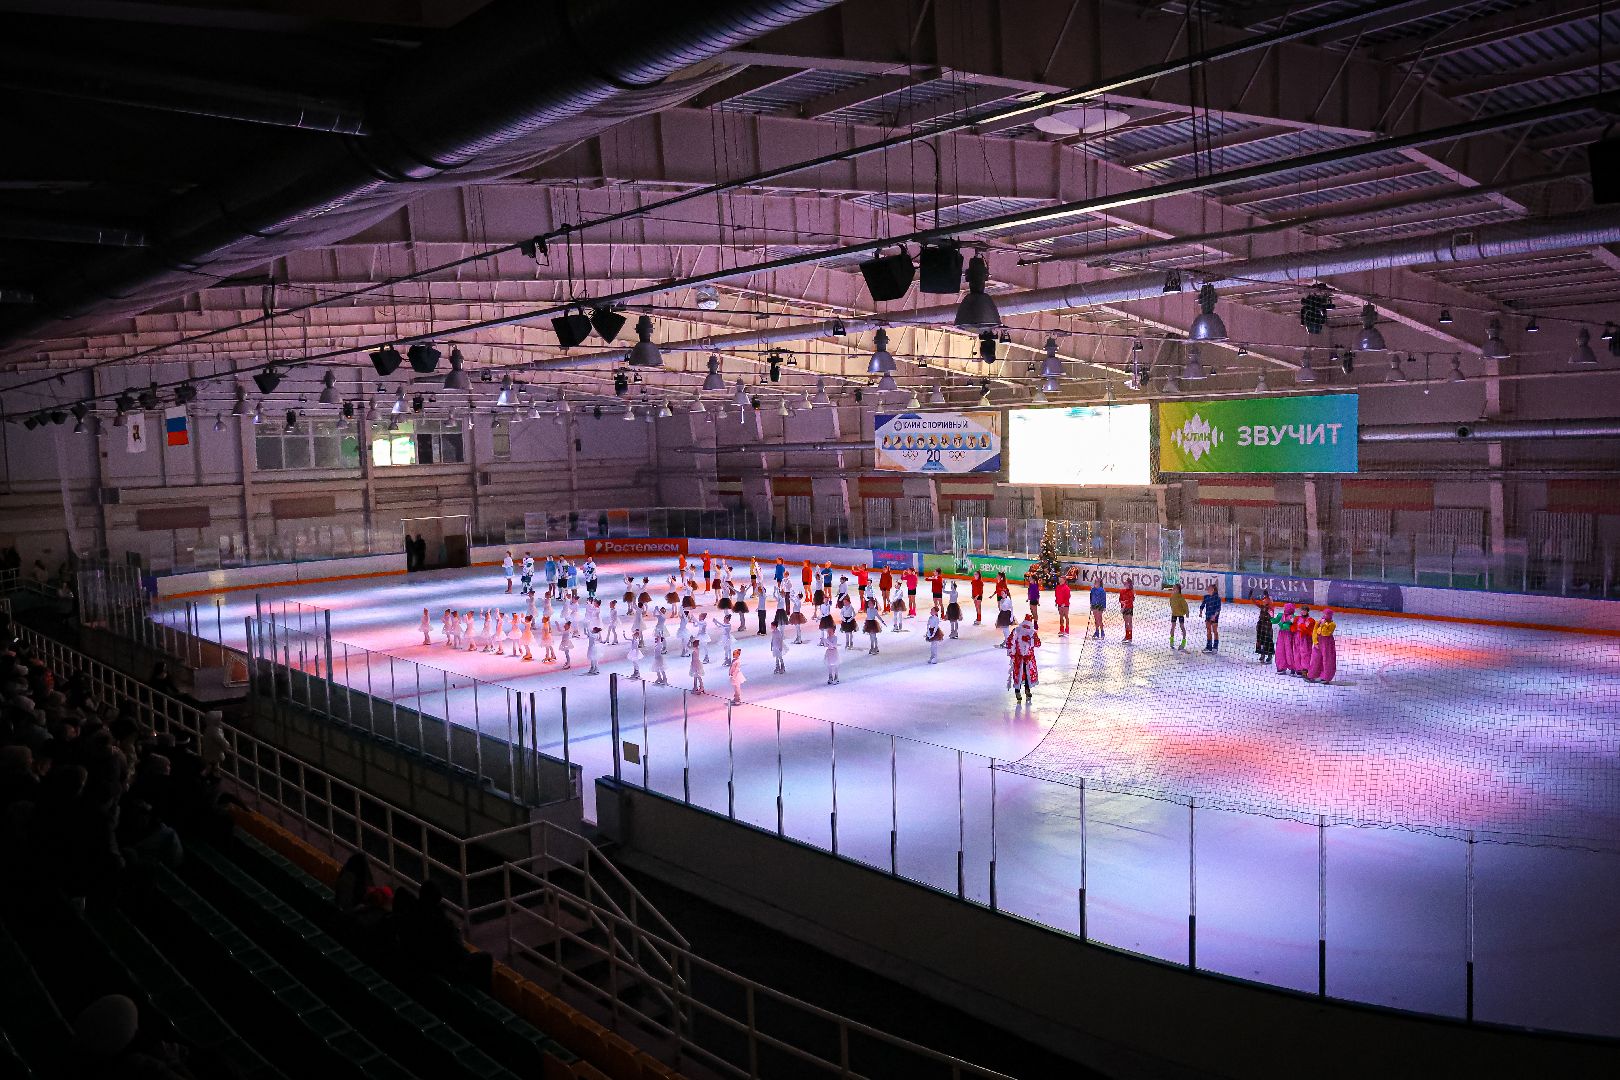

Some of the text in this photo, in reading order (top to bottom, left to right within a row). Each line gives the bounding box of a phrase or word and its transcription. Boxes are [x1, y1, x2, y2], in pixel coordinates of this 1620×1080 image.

[903, 419, 968, 429] КЛИН СПОРТИВНЫЙ
[1237, 423, 1342, 446] ЗВУЧИТ
[926, 450, 940, 462] 20
[605, 542, 679, 552] Ростелеком
[979, 563, 1012, 573] ЗВУЧИТ
[1082, 569, 1218, 590] КЛИН СПОРВНЫЙ
